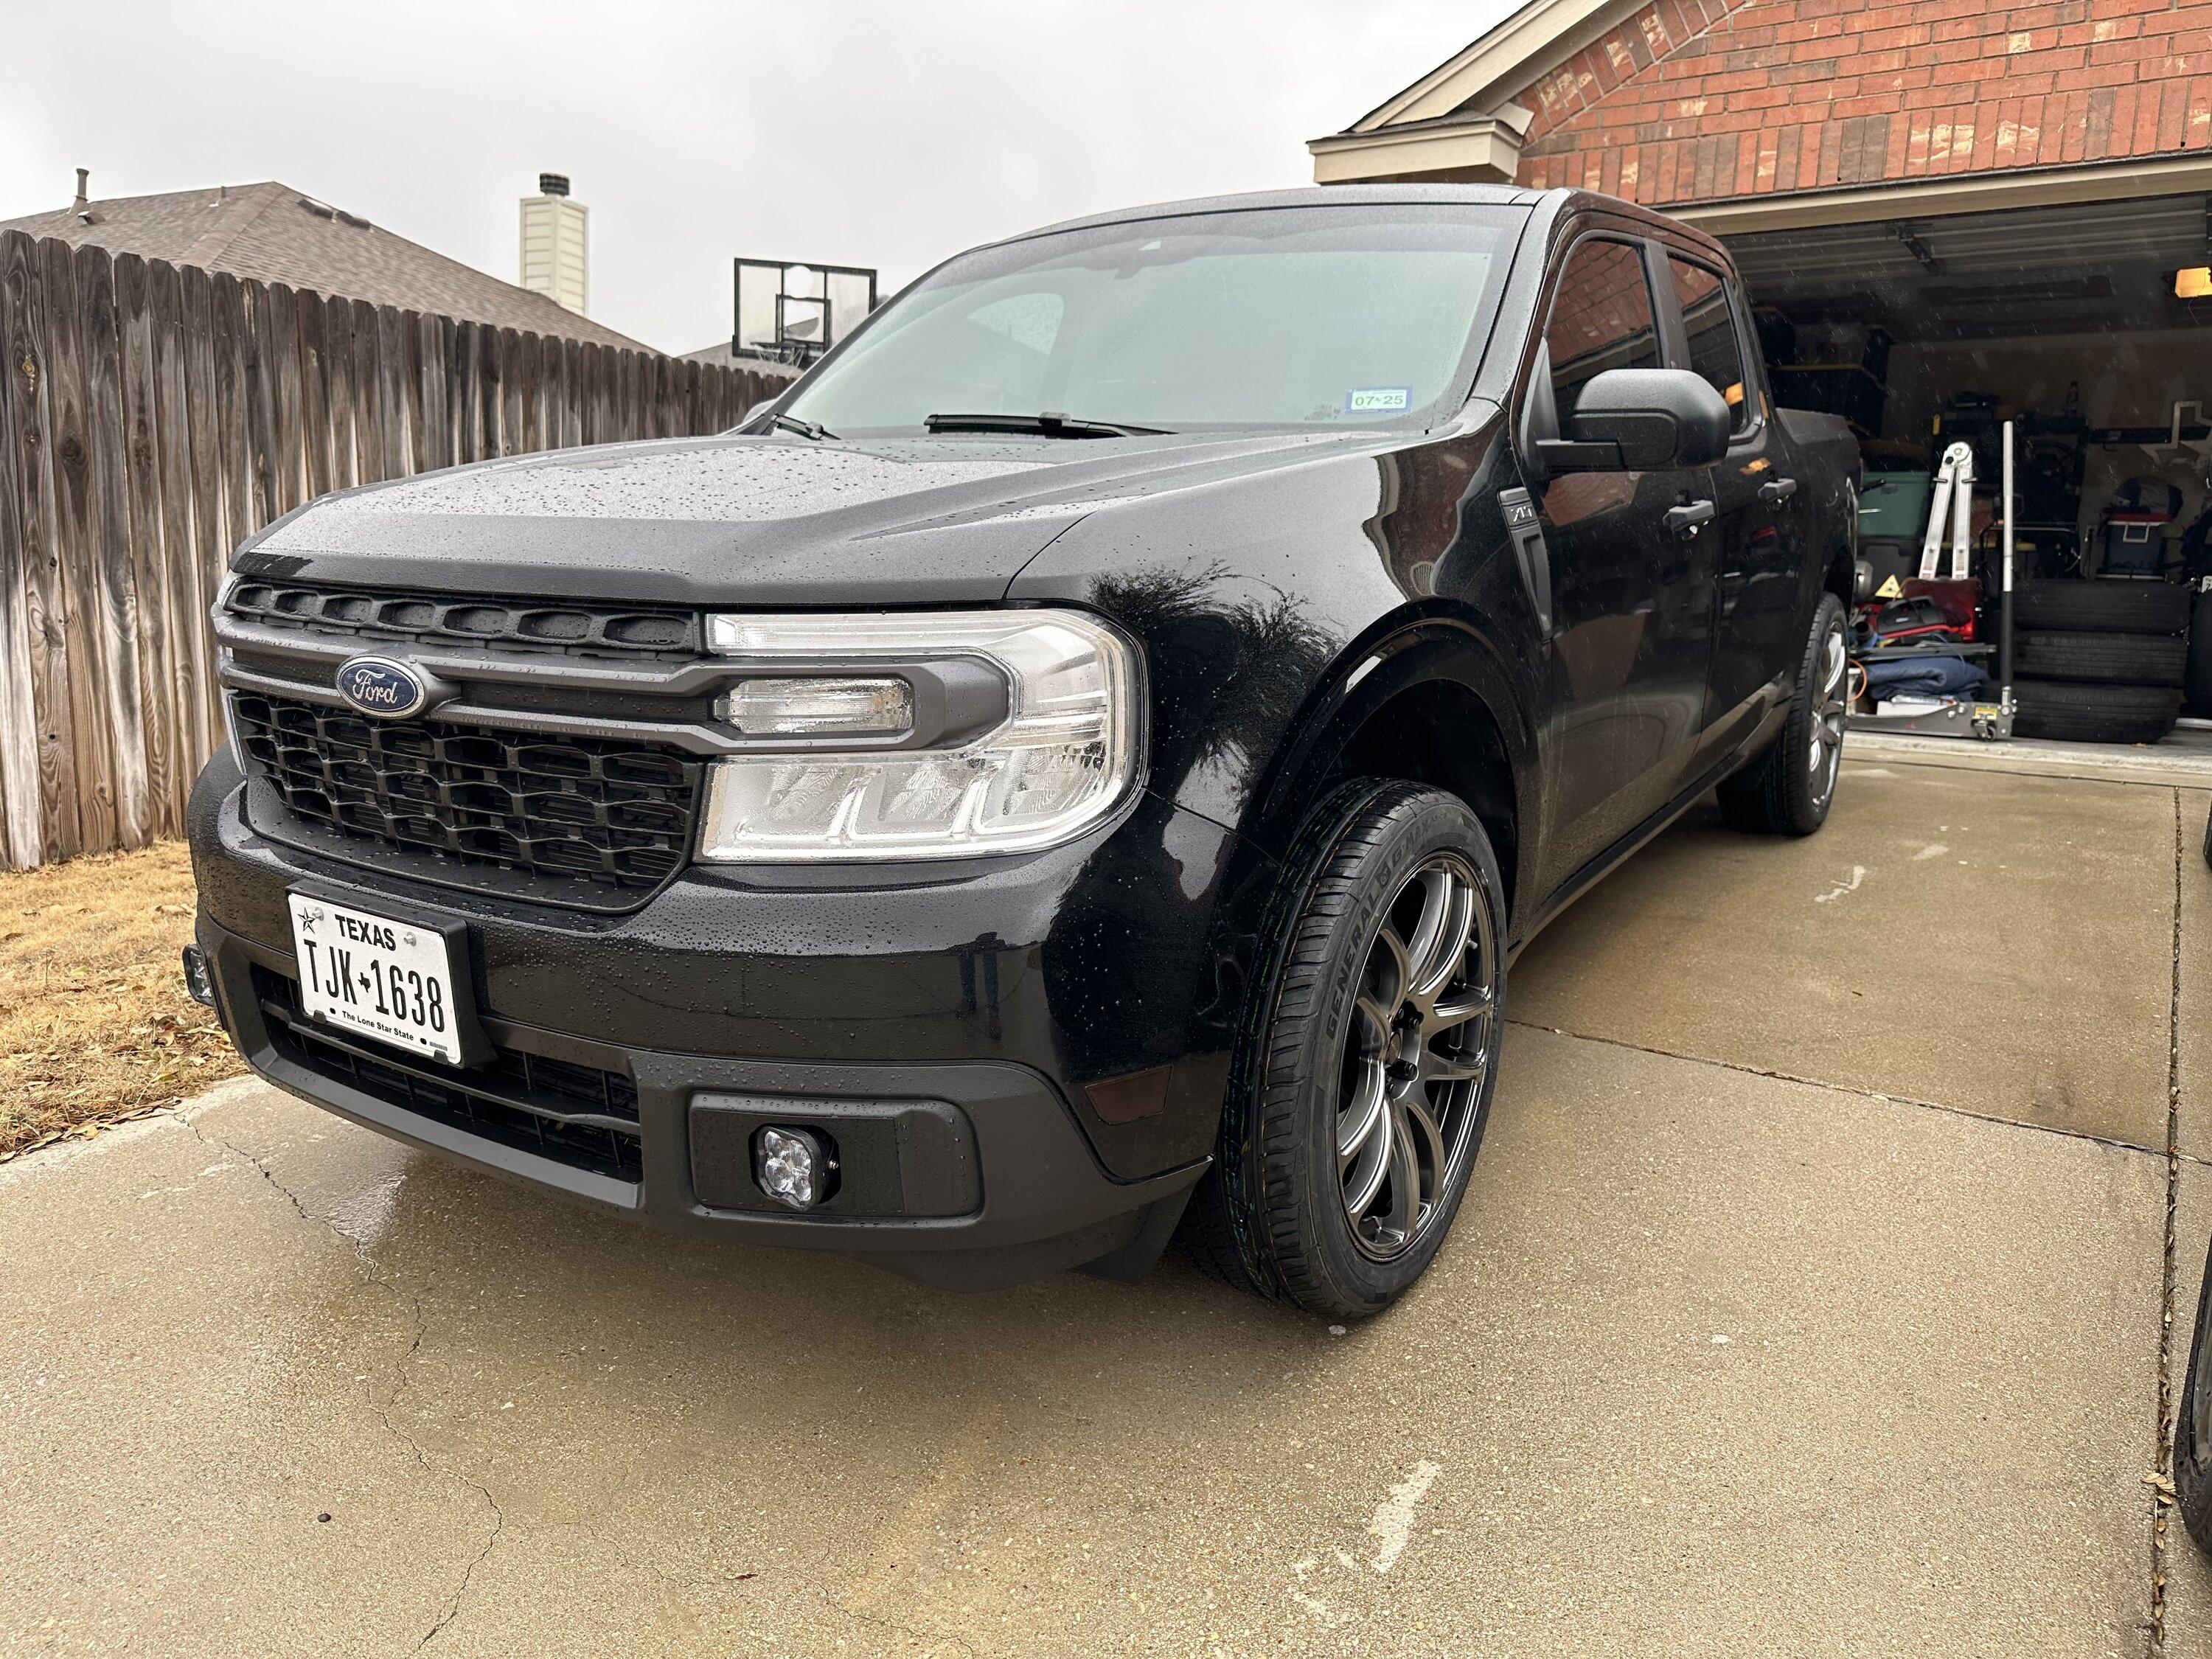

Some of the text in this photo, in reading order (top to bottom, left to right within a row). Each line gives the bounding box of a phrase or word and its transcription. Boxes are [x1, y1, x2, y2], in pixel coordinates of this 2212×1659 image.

[352, 669, 398, 704] Ford
[334, 914, 397, 951] TEXAS
[1326, 892, 1380, 1040] GENERAL
[342, 1010, 414, 1040] The Lone Star State
